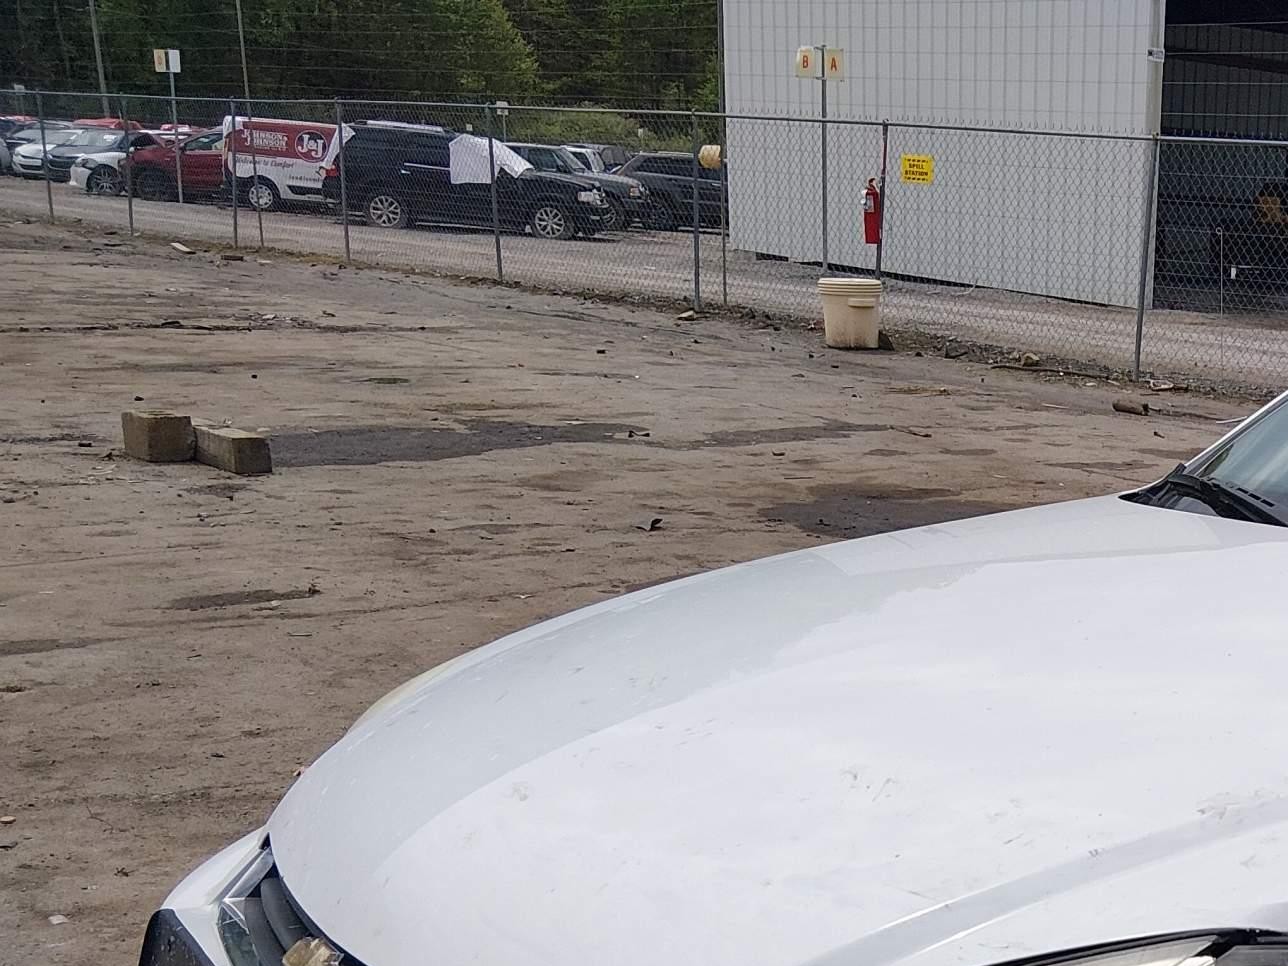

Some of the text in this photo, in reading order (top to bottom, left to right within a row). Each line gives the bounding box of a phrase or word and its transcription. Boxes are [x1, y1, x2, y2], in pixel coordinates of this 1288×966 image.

[802, 55, 809, 69] B
[830, 57, 838, 72] A
[297, 134, 324, 158] J&J
[904, 169, 929, 177] STATION
